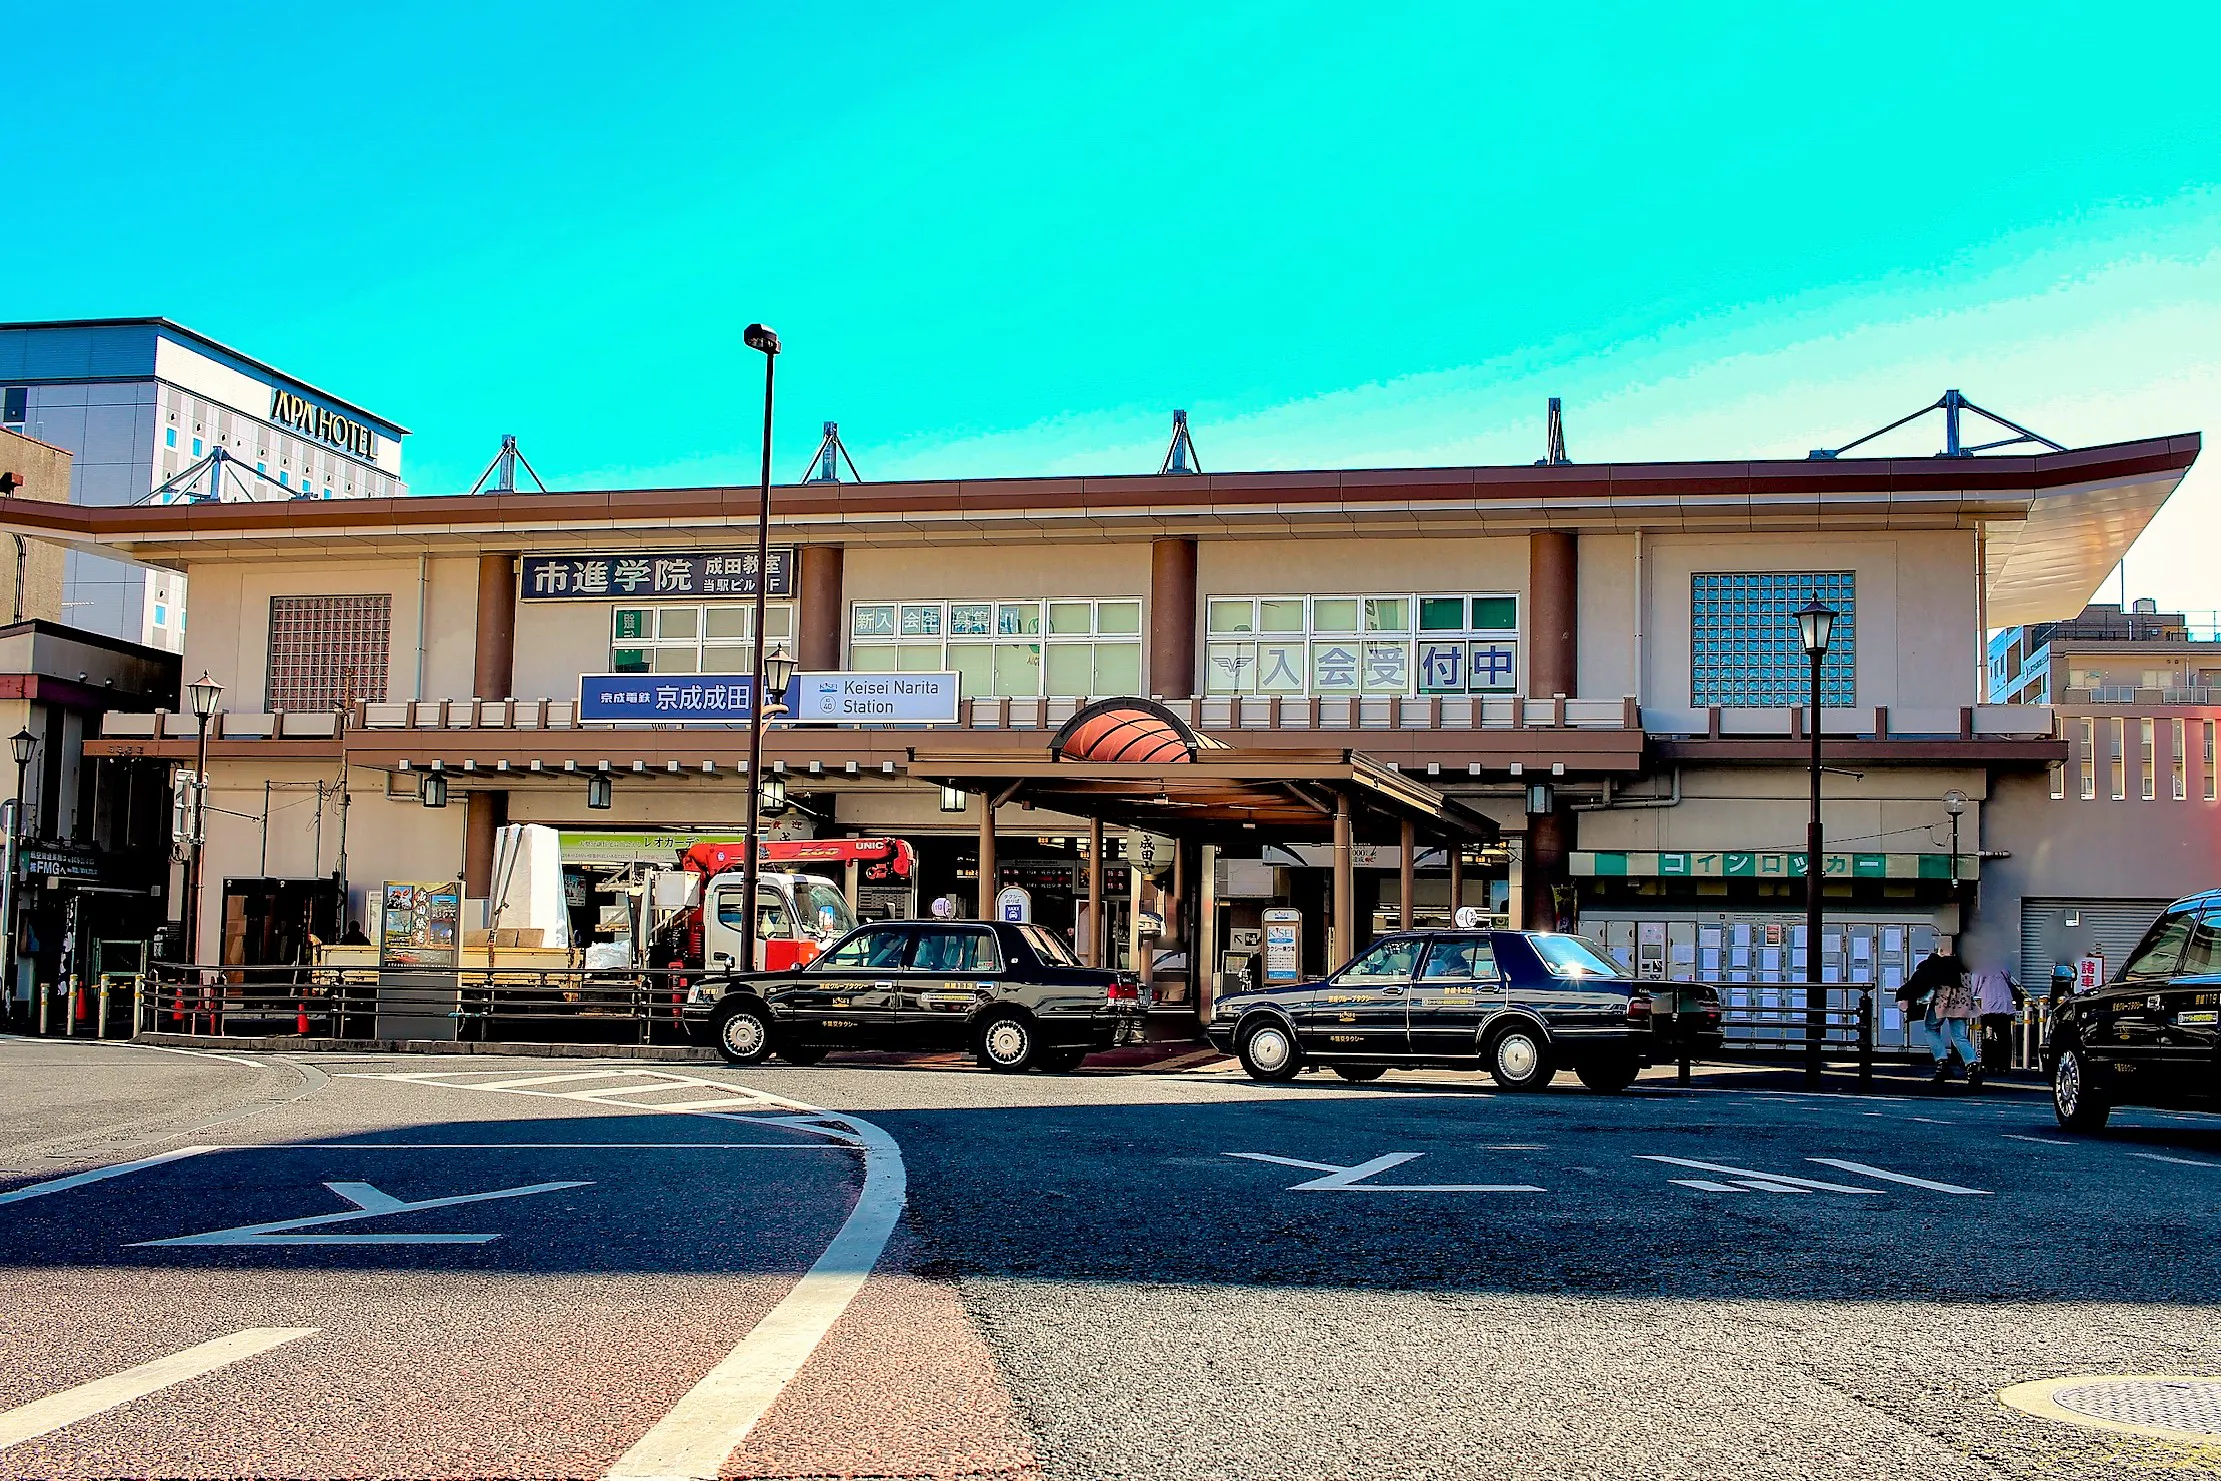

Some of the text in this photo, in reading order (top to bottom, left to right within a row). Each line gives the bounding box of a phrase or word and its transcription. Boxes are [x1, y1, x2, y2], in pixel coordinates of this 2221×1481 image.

[272, 389, 378, 460] APA HOTEL
[705, 554, 781, 575] 成田教室
[534, 558, 693, 593] 市進学院
[703, 578, 781, 593] 当駅ビルF
[1262, 645, 1512, 686] 入会受付中
[844, 681, 939, 694] Keisei Narita
[600, 691, 650, 704] 京成電鉄
[823, 702, 833, 710] 40
[843, 699, 893, 713] Station
[856, 842, 884, 850] UNIC
[1665, 854, 1879, 873] コインロッカー
